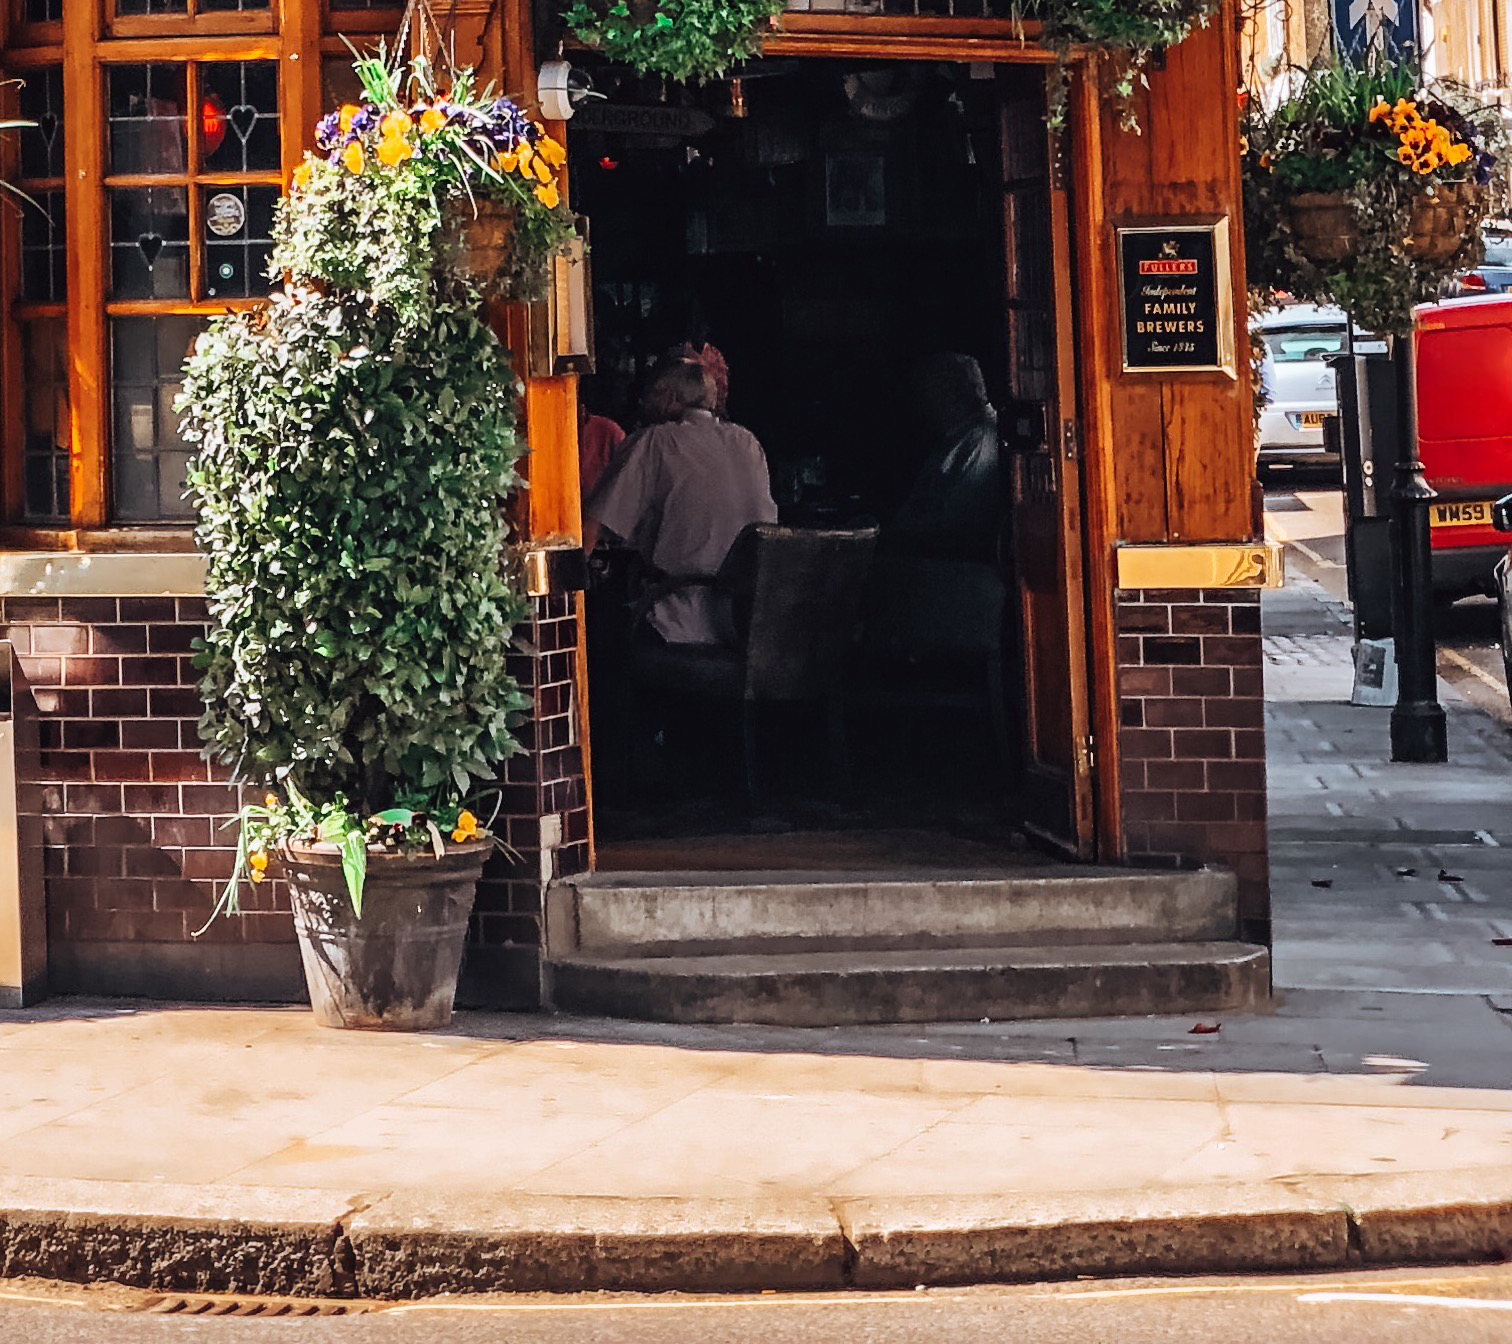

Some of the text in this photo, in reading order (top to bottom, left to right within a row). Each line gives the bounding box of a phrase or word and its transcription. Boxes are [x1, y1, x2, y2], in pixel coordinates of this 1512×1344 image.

[1141, 284, 1198, 301] Independent
[1144, 302, 1196, 315] FAMILY
[1136, 320, 1205, 333] BREWERS
